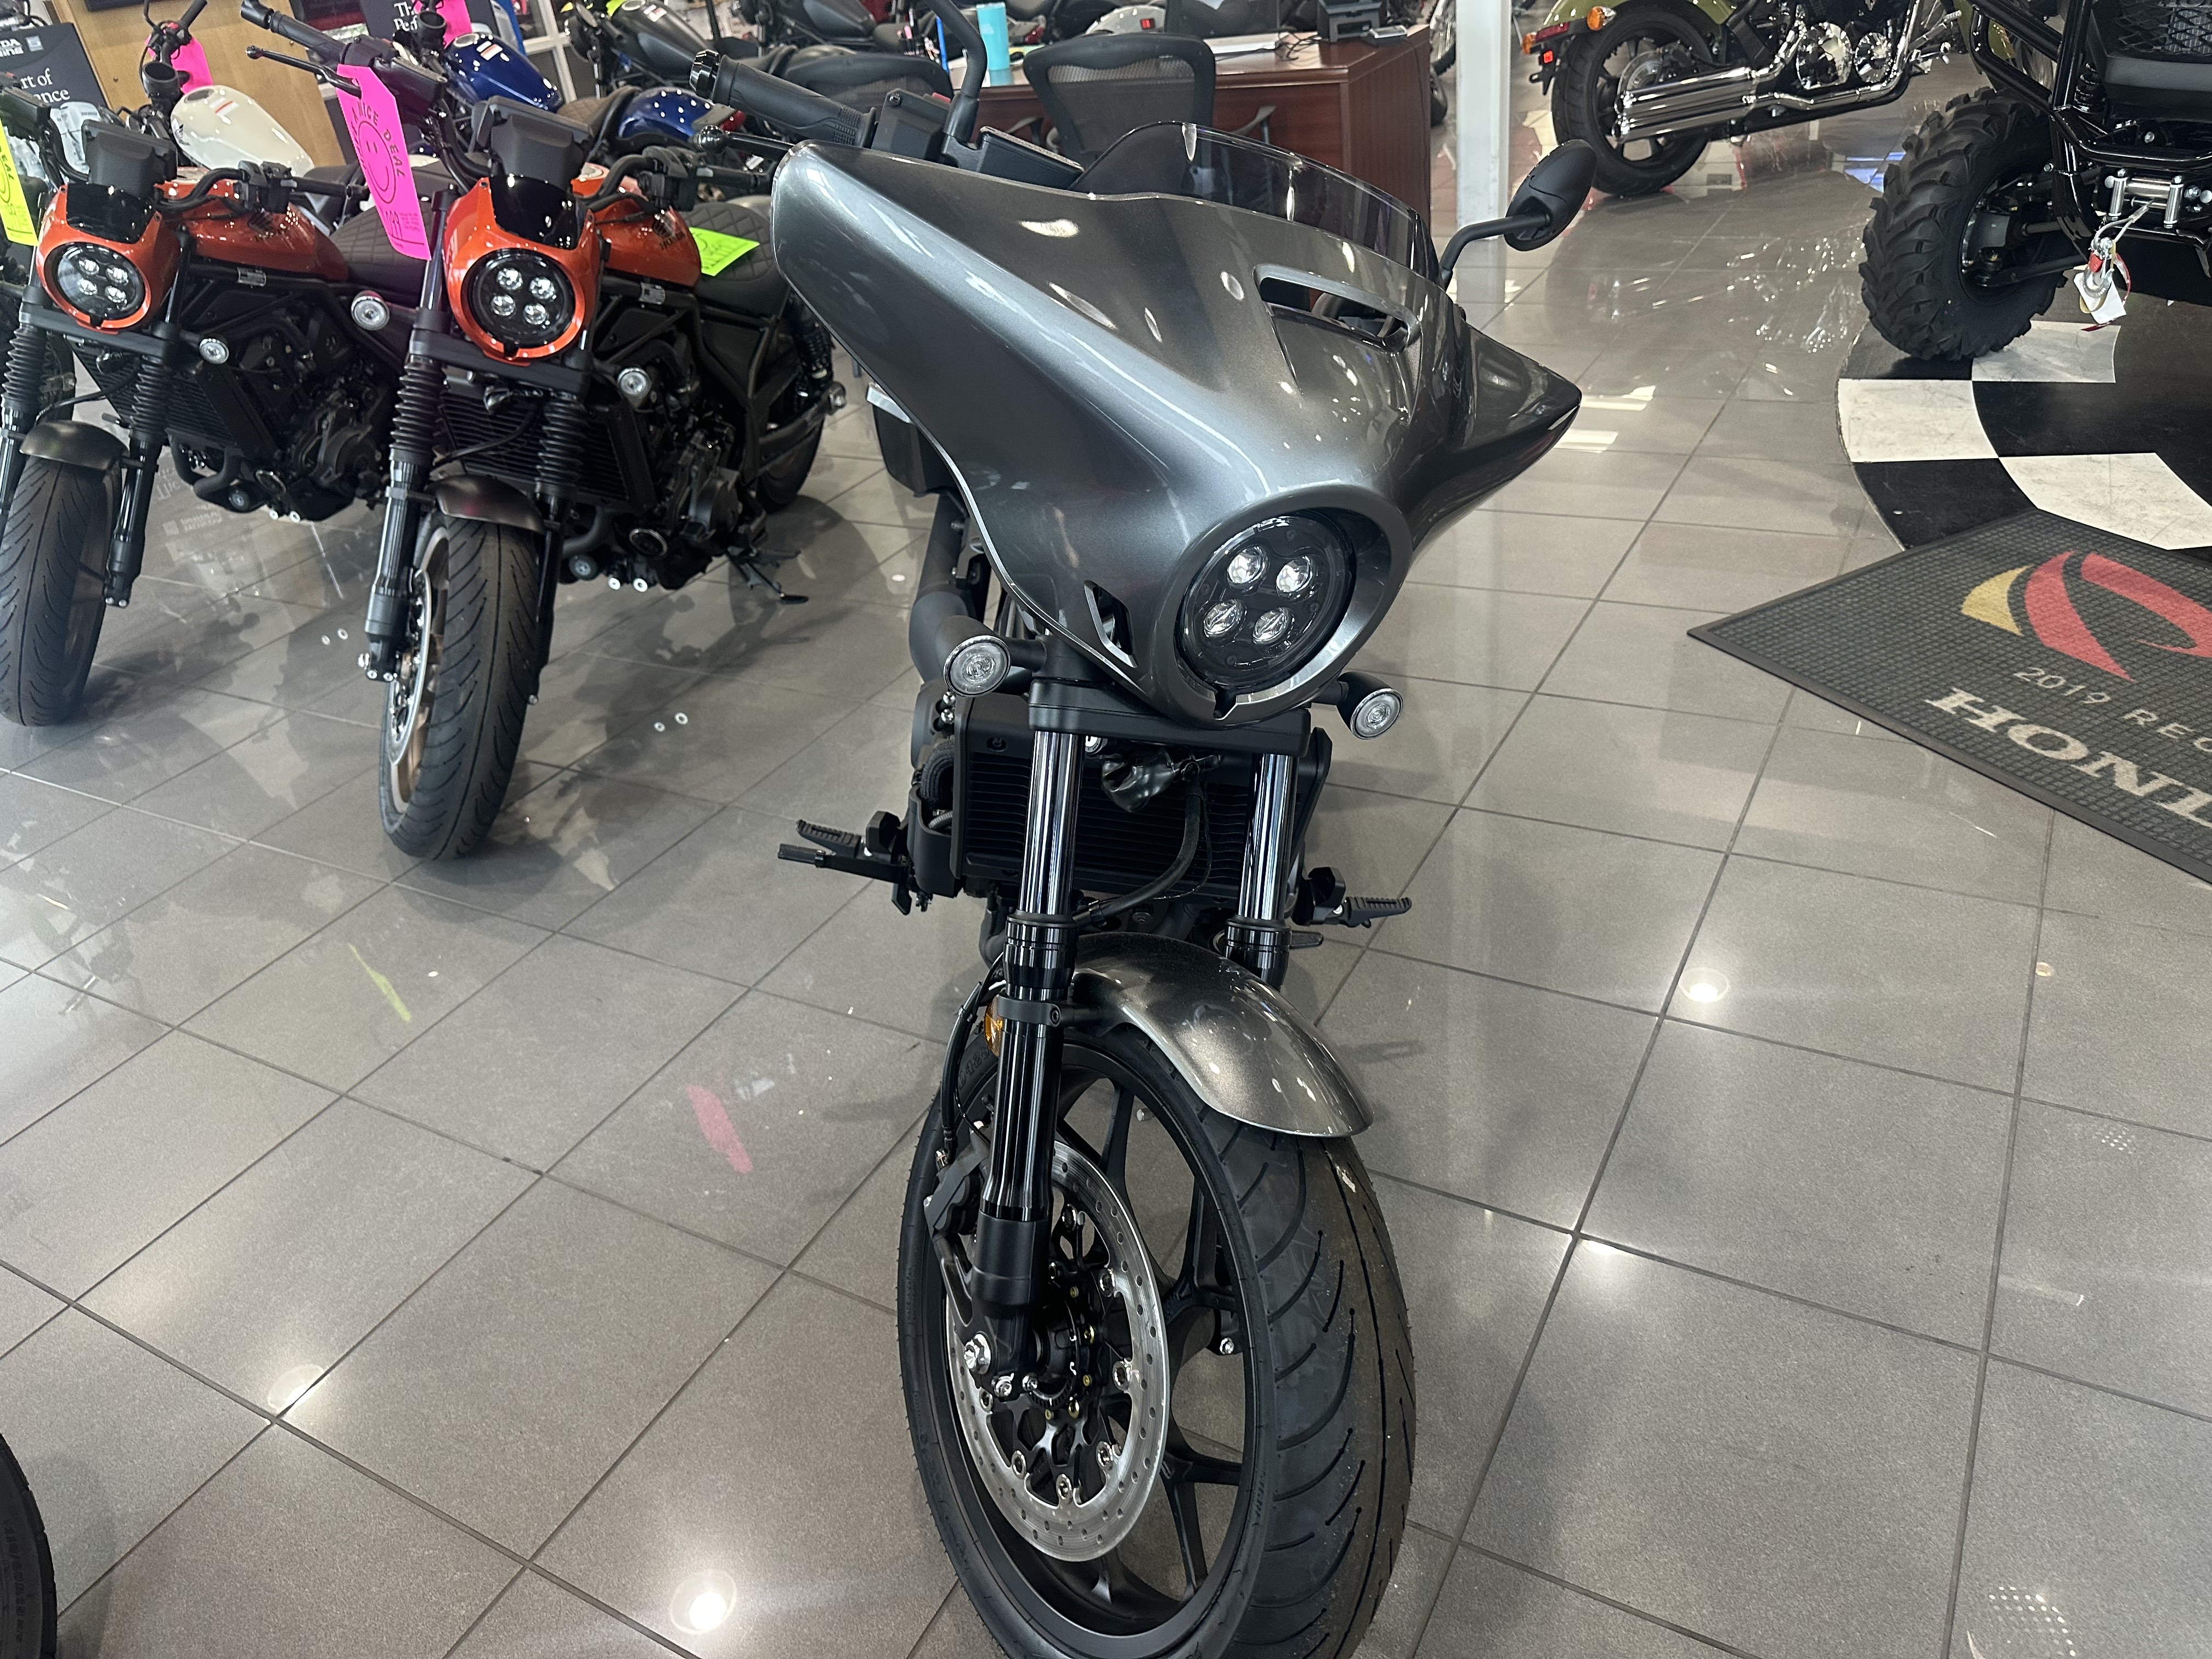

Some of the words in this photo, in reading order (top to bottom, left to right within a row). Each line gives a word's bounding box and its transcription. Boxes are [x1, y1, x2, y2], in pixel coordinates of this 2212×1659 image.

[37, 67, 53, 86] of
[357, 101, 379, 126] NICE
[383, 128, 405, 177] DEAL
[0, 145, 15, 180] EAL
[2013, 667, 2112, 704] 2019
